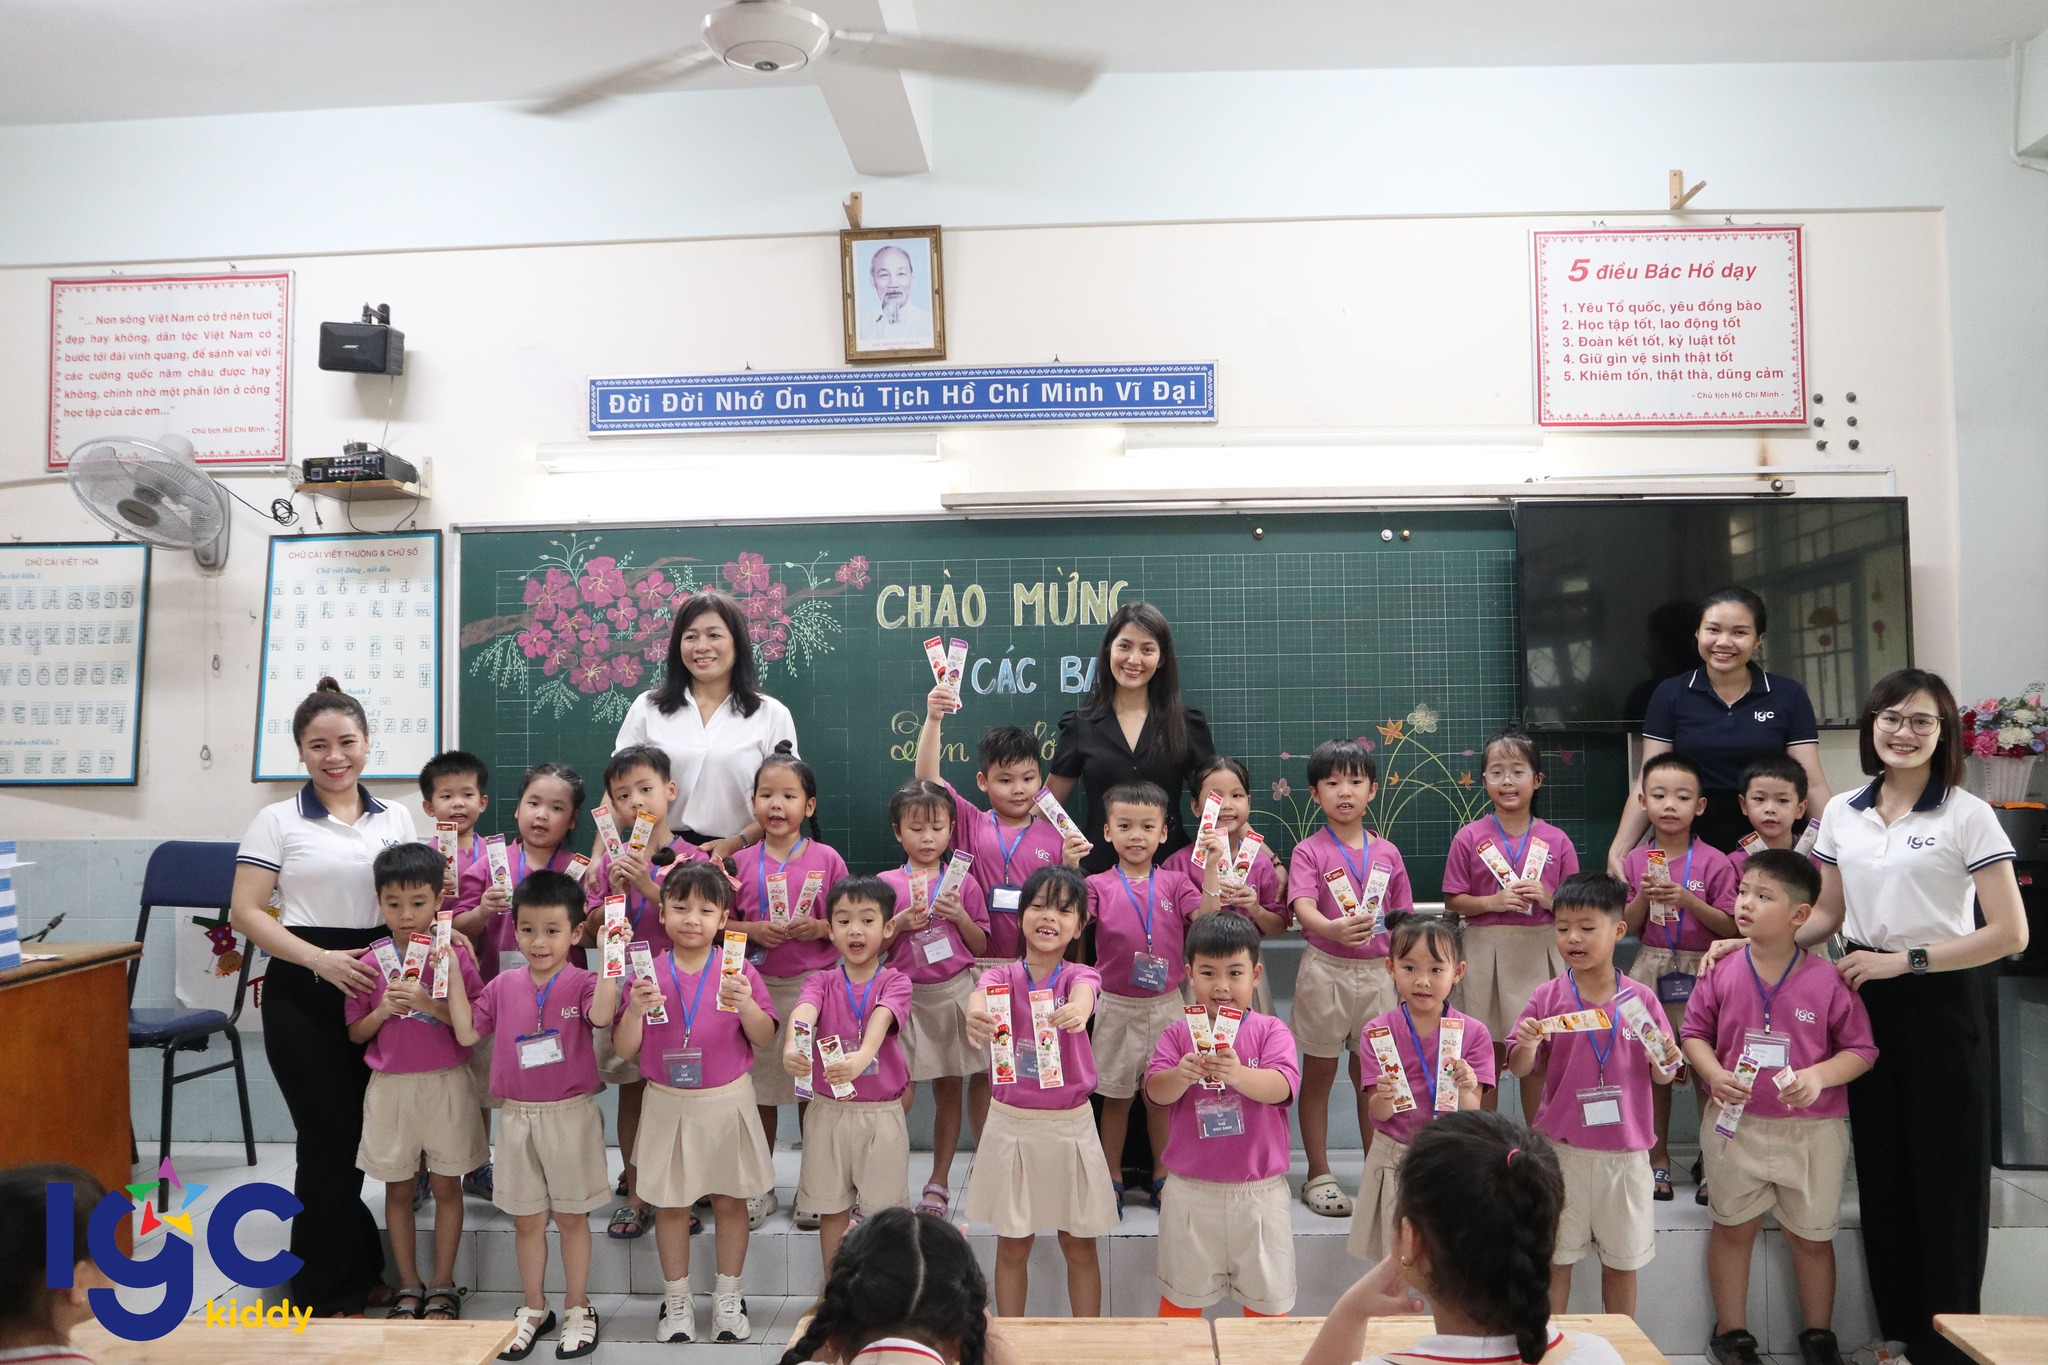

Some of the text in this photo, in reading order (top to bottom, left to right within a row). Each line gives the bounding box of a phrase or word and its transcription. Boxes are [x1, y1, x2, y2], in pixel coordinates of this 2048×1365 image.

[1568, 258, 1758, 282] 5 điều Bác Hồ dạy
[1562, 298, 1763, 316] 1. Yêu Tổ quốc, yêu đồng bào
[96, 315, 116, 325] Non
[171, 313, 195, 323] Nam
[1562, 316, 1741, 332] 2. Học tập tốt, lao động tốt
[90, 334, 108, 344] hay
[230, 330, 253, 340] Nam
[1563, 332, 1736, 349] 3. Đoàn kết tốt, kỷ luật tốt
[237, 348, 252, 358] vai
[1563, 353, 1575, 364] 4.
[1606, 353, 1628, 367] gìn
[1631, 351, 1648, 366] vệ
[1652, 352, 1680, 364] sinh
[1684, 351, 1712, 364] thật
[1714, 349, 1734, 363] tốt
[252, 367, 270, 377] hay
[1563, 367, 1783, 382] 5. Khiêm tốn, thật thà, dũng cảm
[609, 380, 1196, 414] Đời Đời Nhớ Ơn Chủ Tịch Hồ Chí Minh Vĩ Đại
[1760, 390, 1778, 398] Minh
[82, 557, 99, 565] HOA
[876, 568, 987, 629] CHÀO
[971, 645, 1037, 694] CÁC
